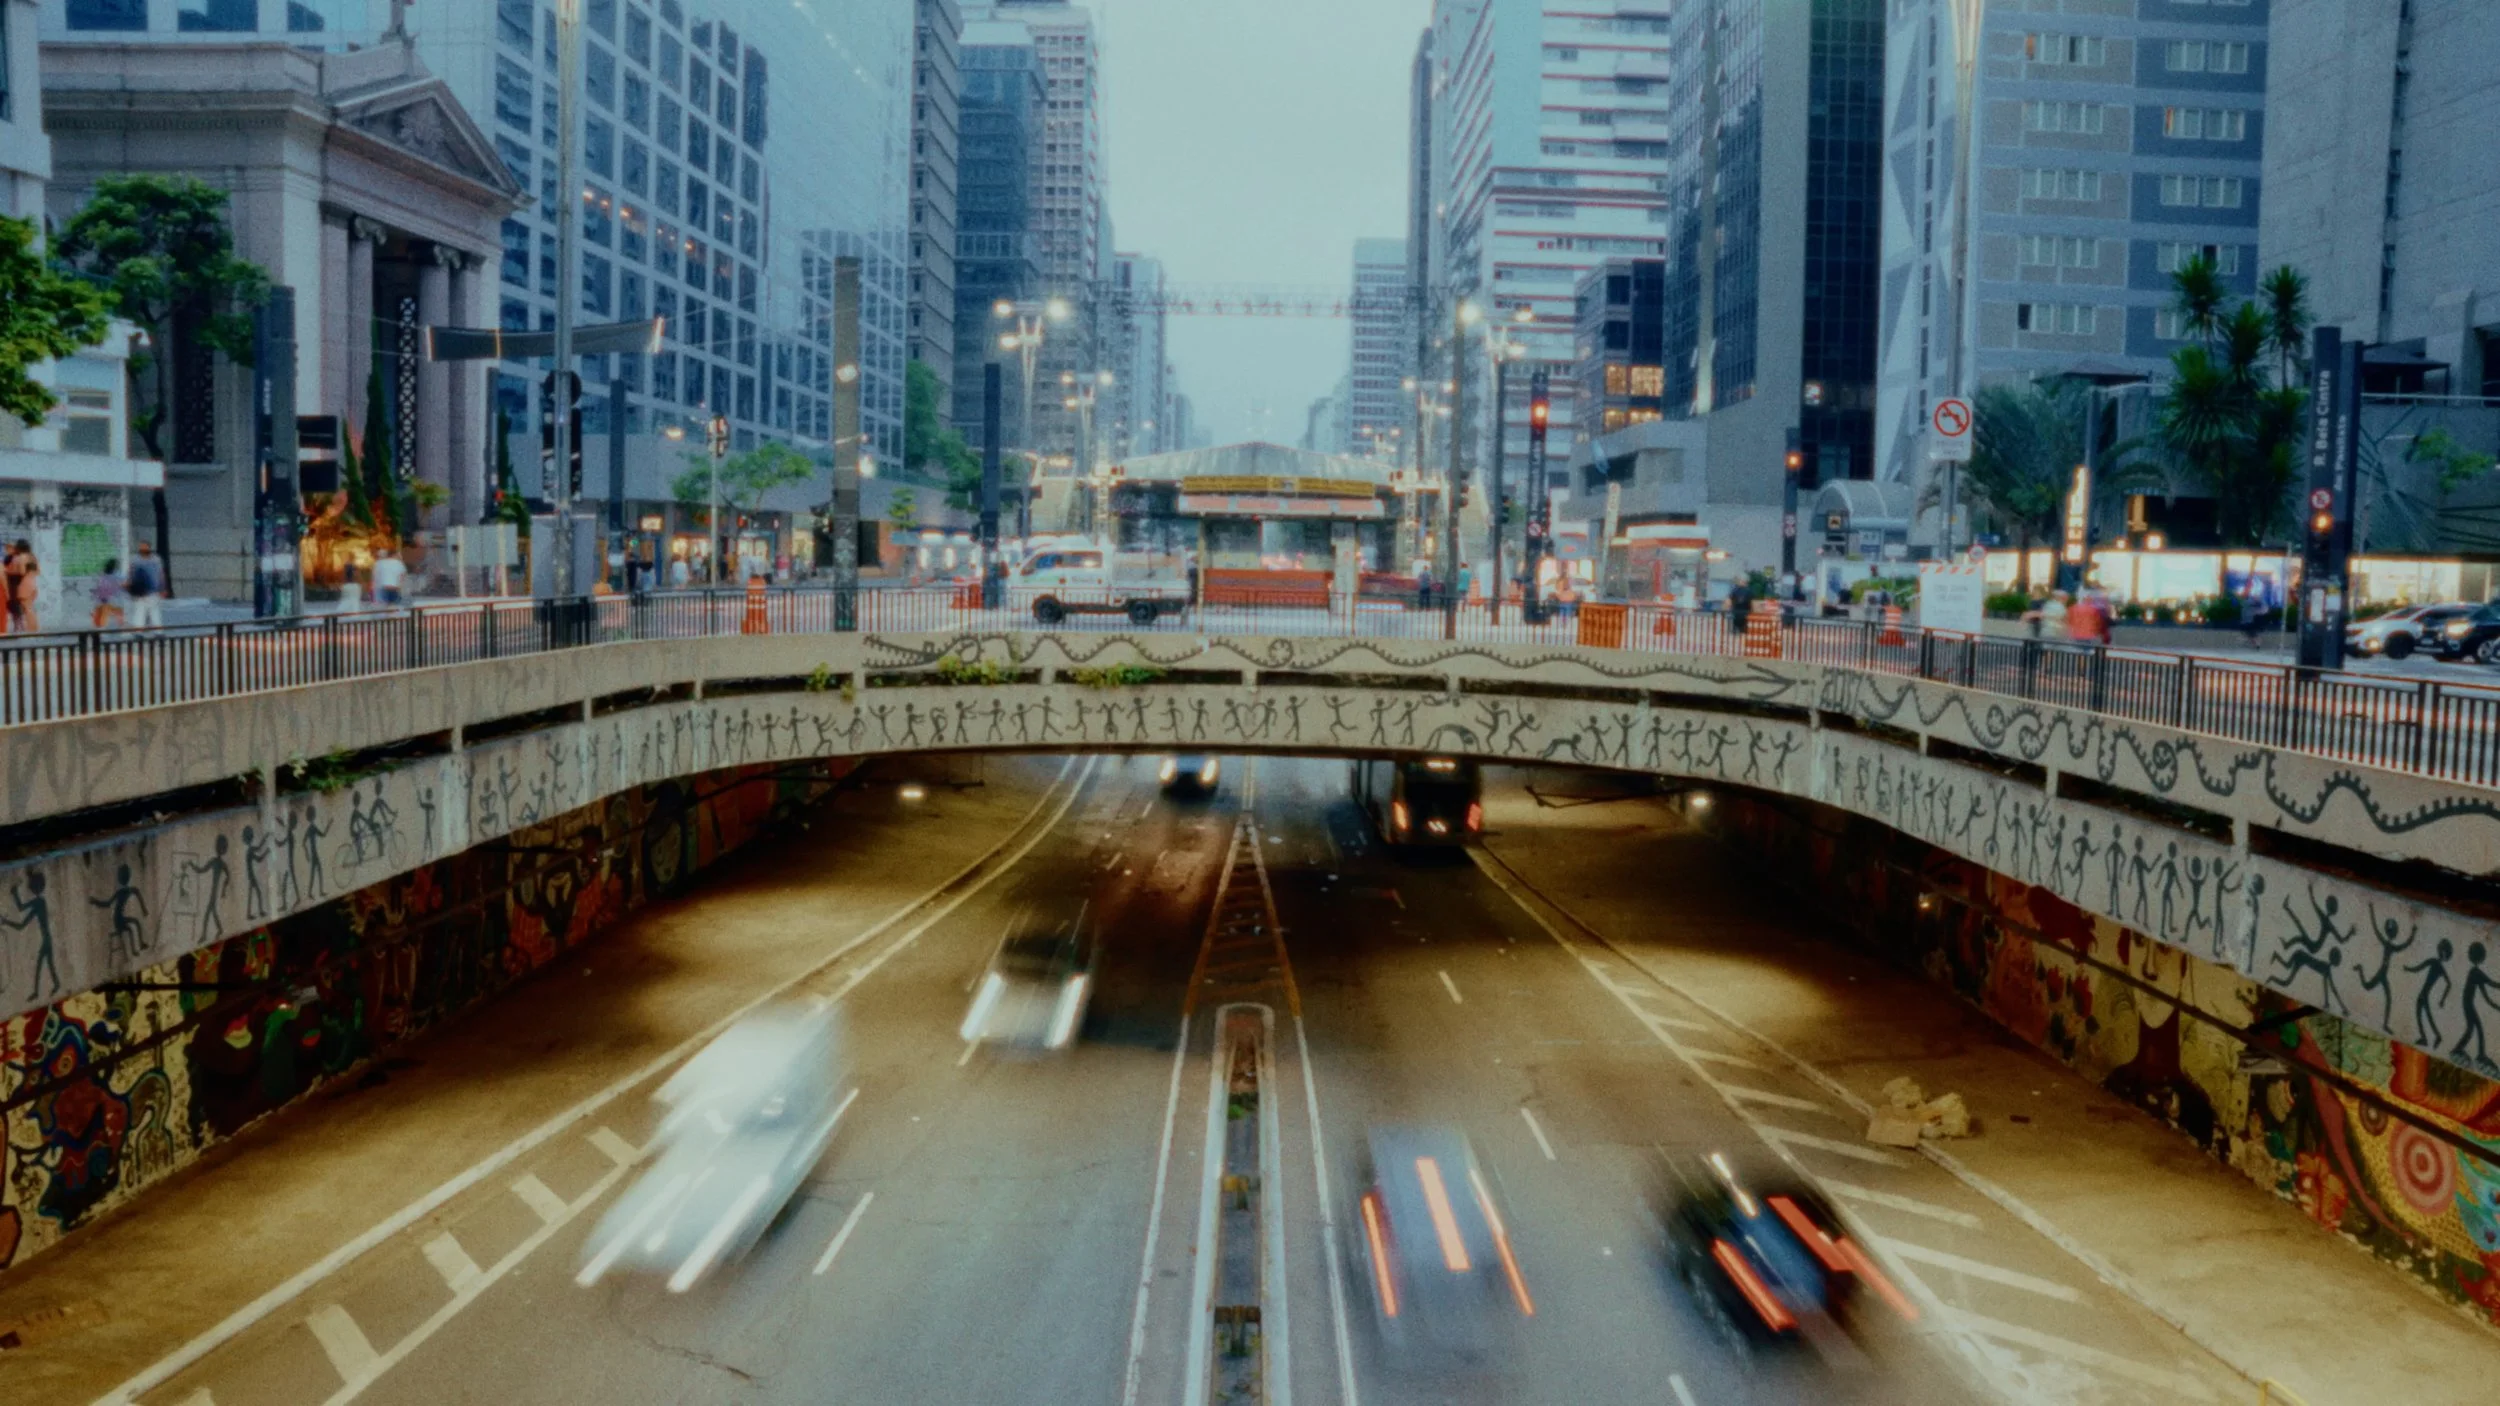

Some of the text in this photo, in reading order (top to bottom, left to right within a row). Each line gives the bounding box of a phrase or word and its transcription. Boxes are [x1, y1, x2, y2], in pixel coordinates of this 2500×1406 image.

[2313, 370, 2331, 467] R. Bela Cintra
[2335, 415, 2347, 471] Paulista
